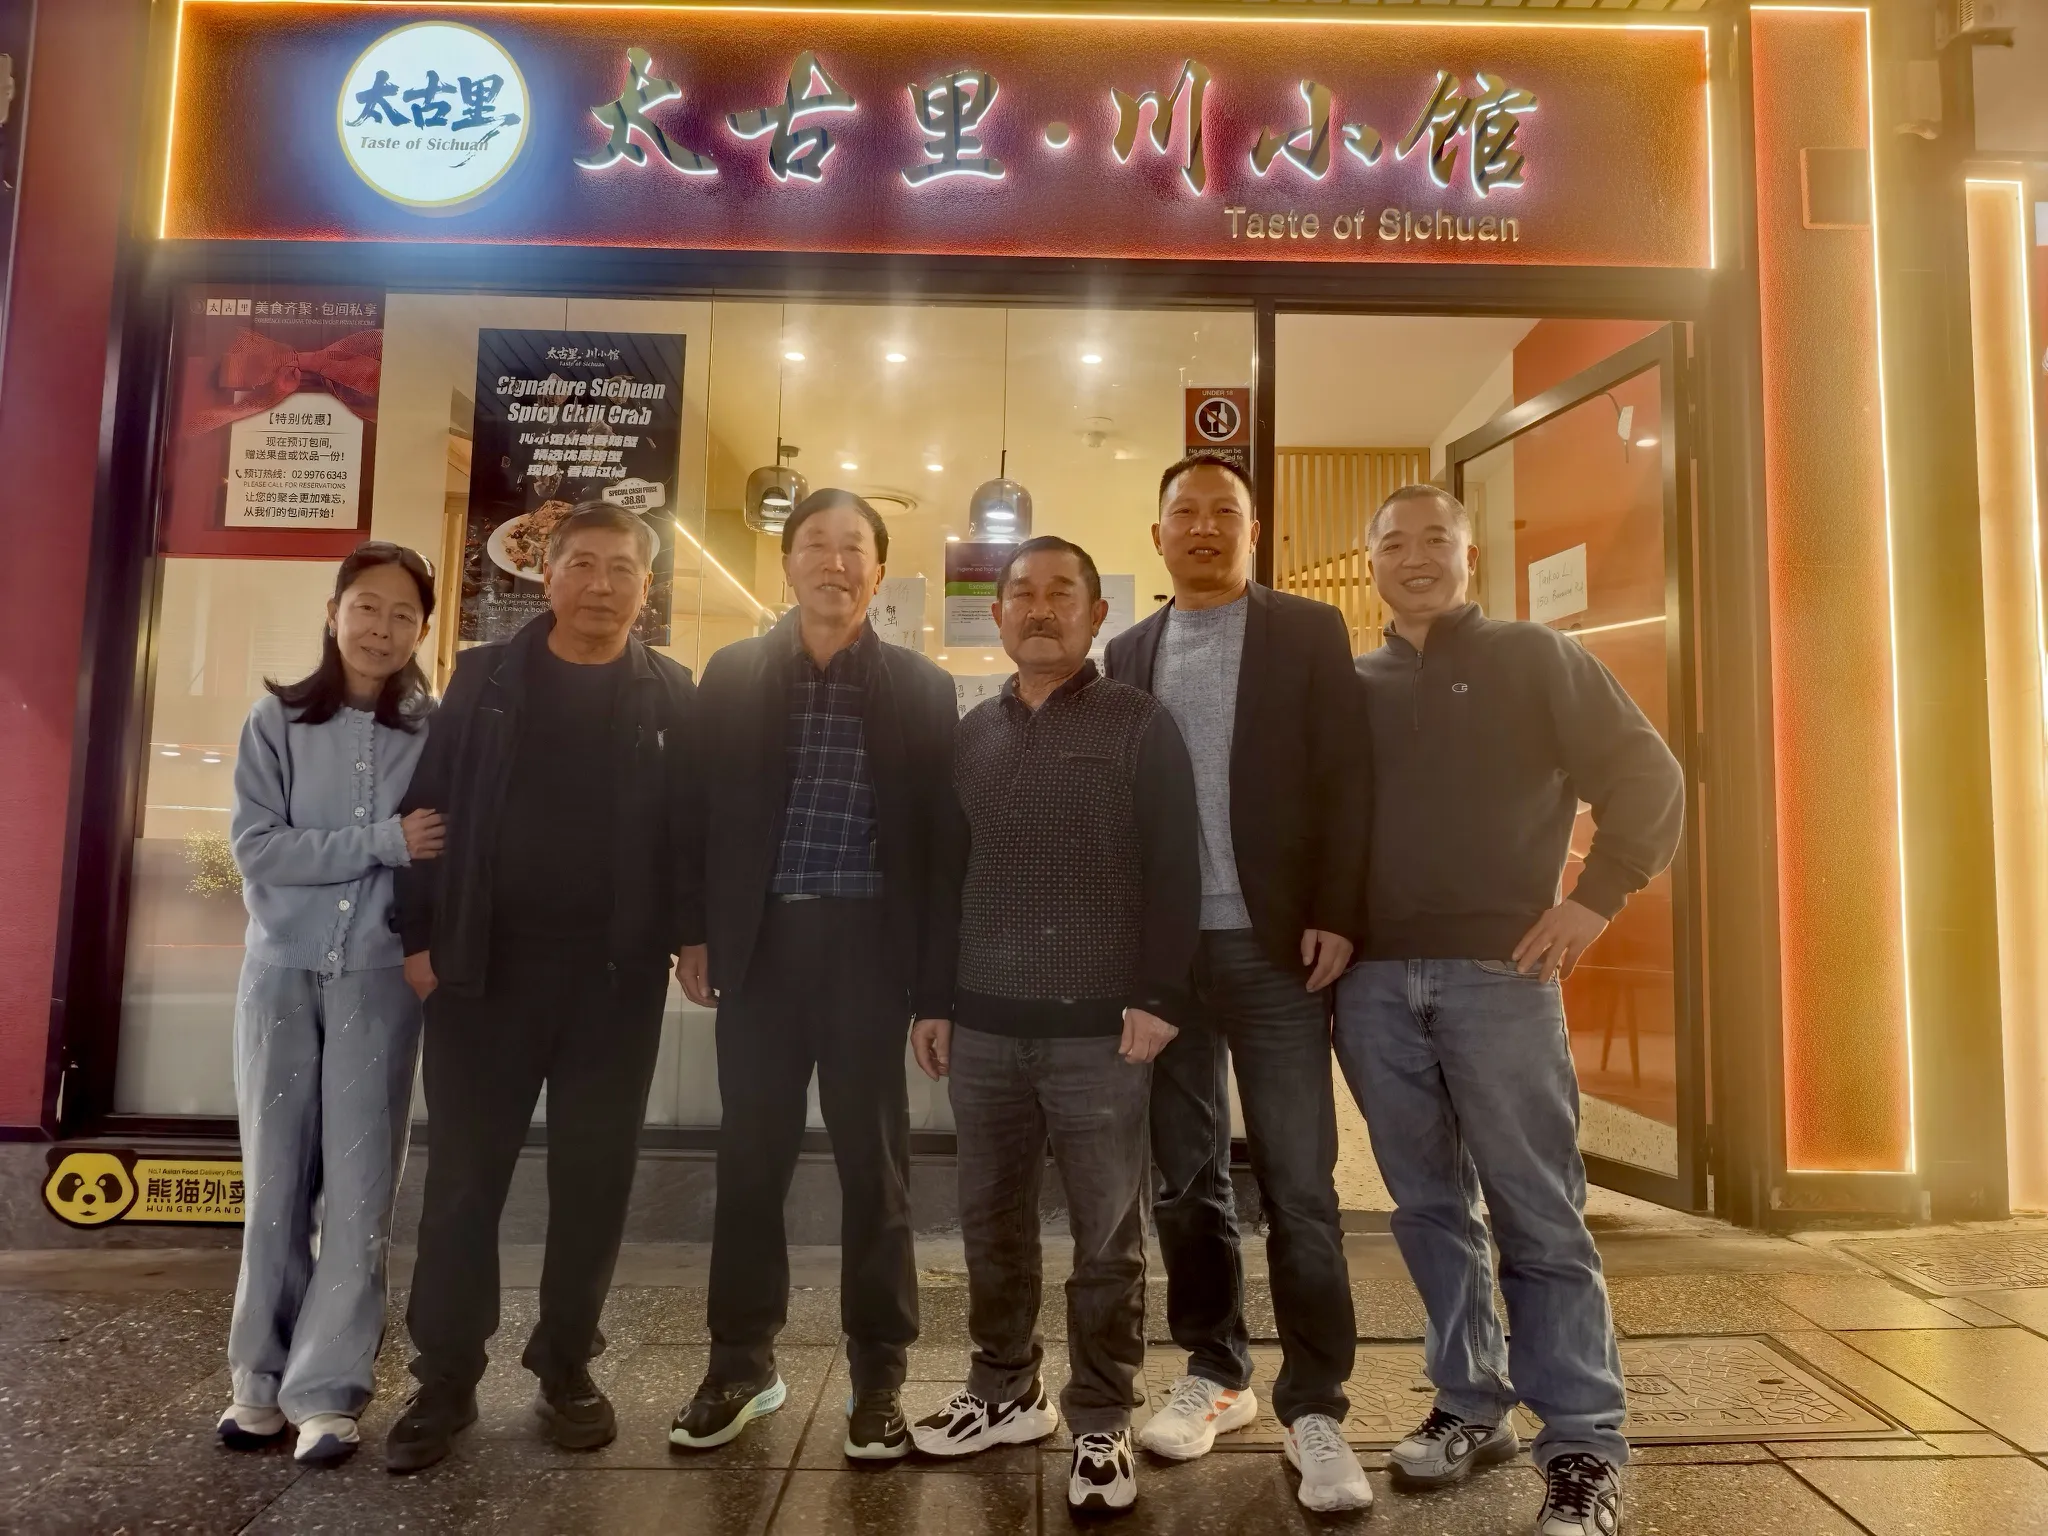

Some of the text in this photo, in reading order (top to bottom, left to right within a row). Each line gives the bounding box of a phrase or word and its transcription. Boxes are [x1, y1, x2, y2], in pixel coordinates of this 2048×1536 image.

[345, 70, 521, 131] 太古里
[360, 137, 489, 151] Taste of Sichuan
[1224, 206, 1520, 242] Taste of Sichuan
[208, 301, 250, 314] 太古里
[496, 376, 666, 400] Signature Sichuan
[508, 402, 652, 425] Spicy Chili Crab
[292, 470, 303, 479] 02
[304, 470, 325, 480] 9976
[326, 471, 347, 480] 6343
[146, 1206, 245, 1214] HUNGRYPAND
